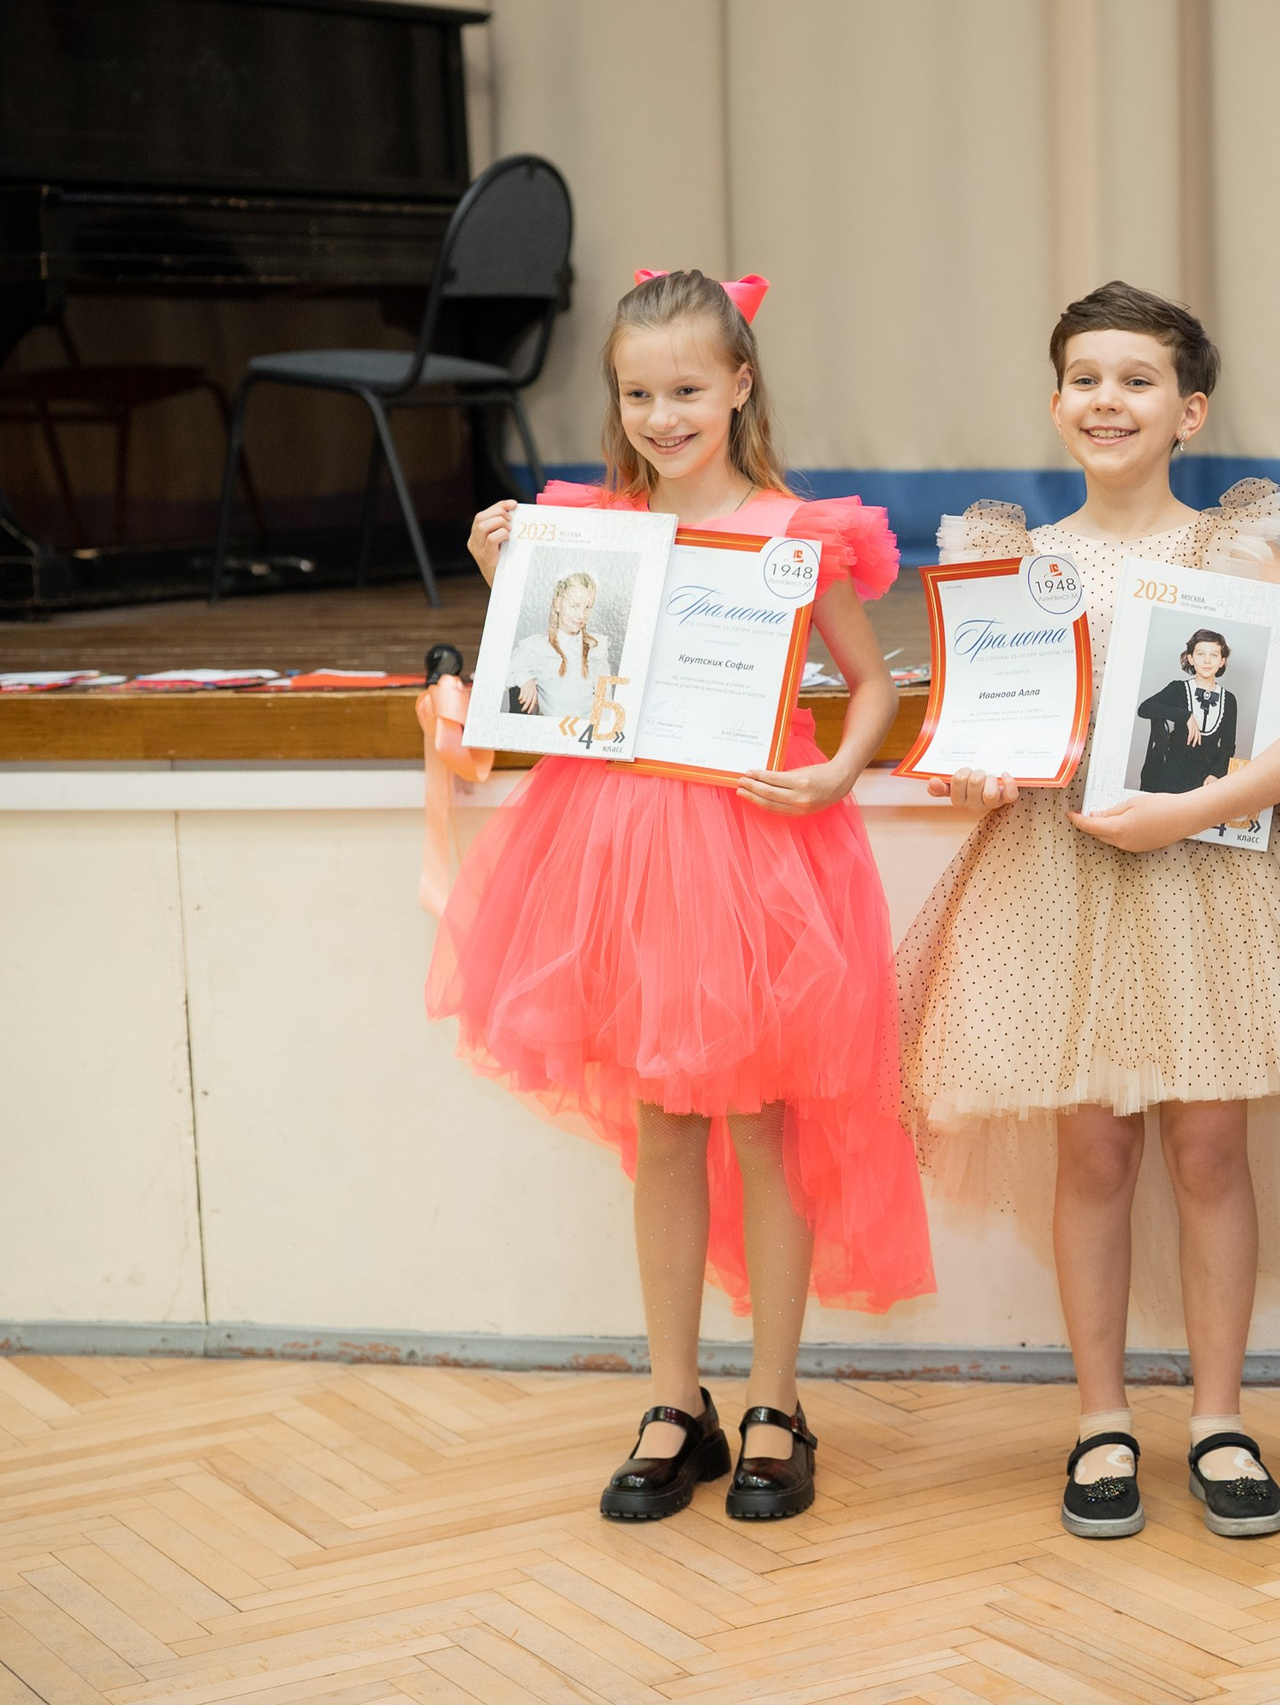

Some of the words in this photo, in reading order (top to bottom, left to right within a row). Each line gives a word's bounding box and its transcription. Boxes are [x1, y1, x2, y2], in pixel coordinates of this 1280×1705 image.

[517, 522, 557, 541] 2023
[772, 563, 813, 580] 1948
[1035, 578, 1077, 594] 1948
[1133, 579, 1178, 604] 2023
[666, 586, 788, 625] Грамота
[1181, 594, 1205, 603] МОСКВА
[954, 618, 1067, 664] Грамота
[678, 654, 722, 667] Крутских
[724, 660, 754, 670] София
[978, 690, 1016, 699] Иванова
[1018, 688, 1040, 697] Алла
[1237, 834, 1260, 844] класс
